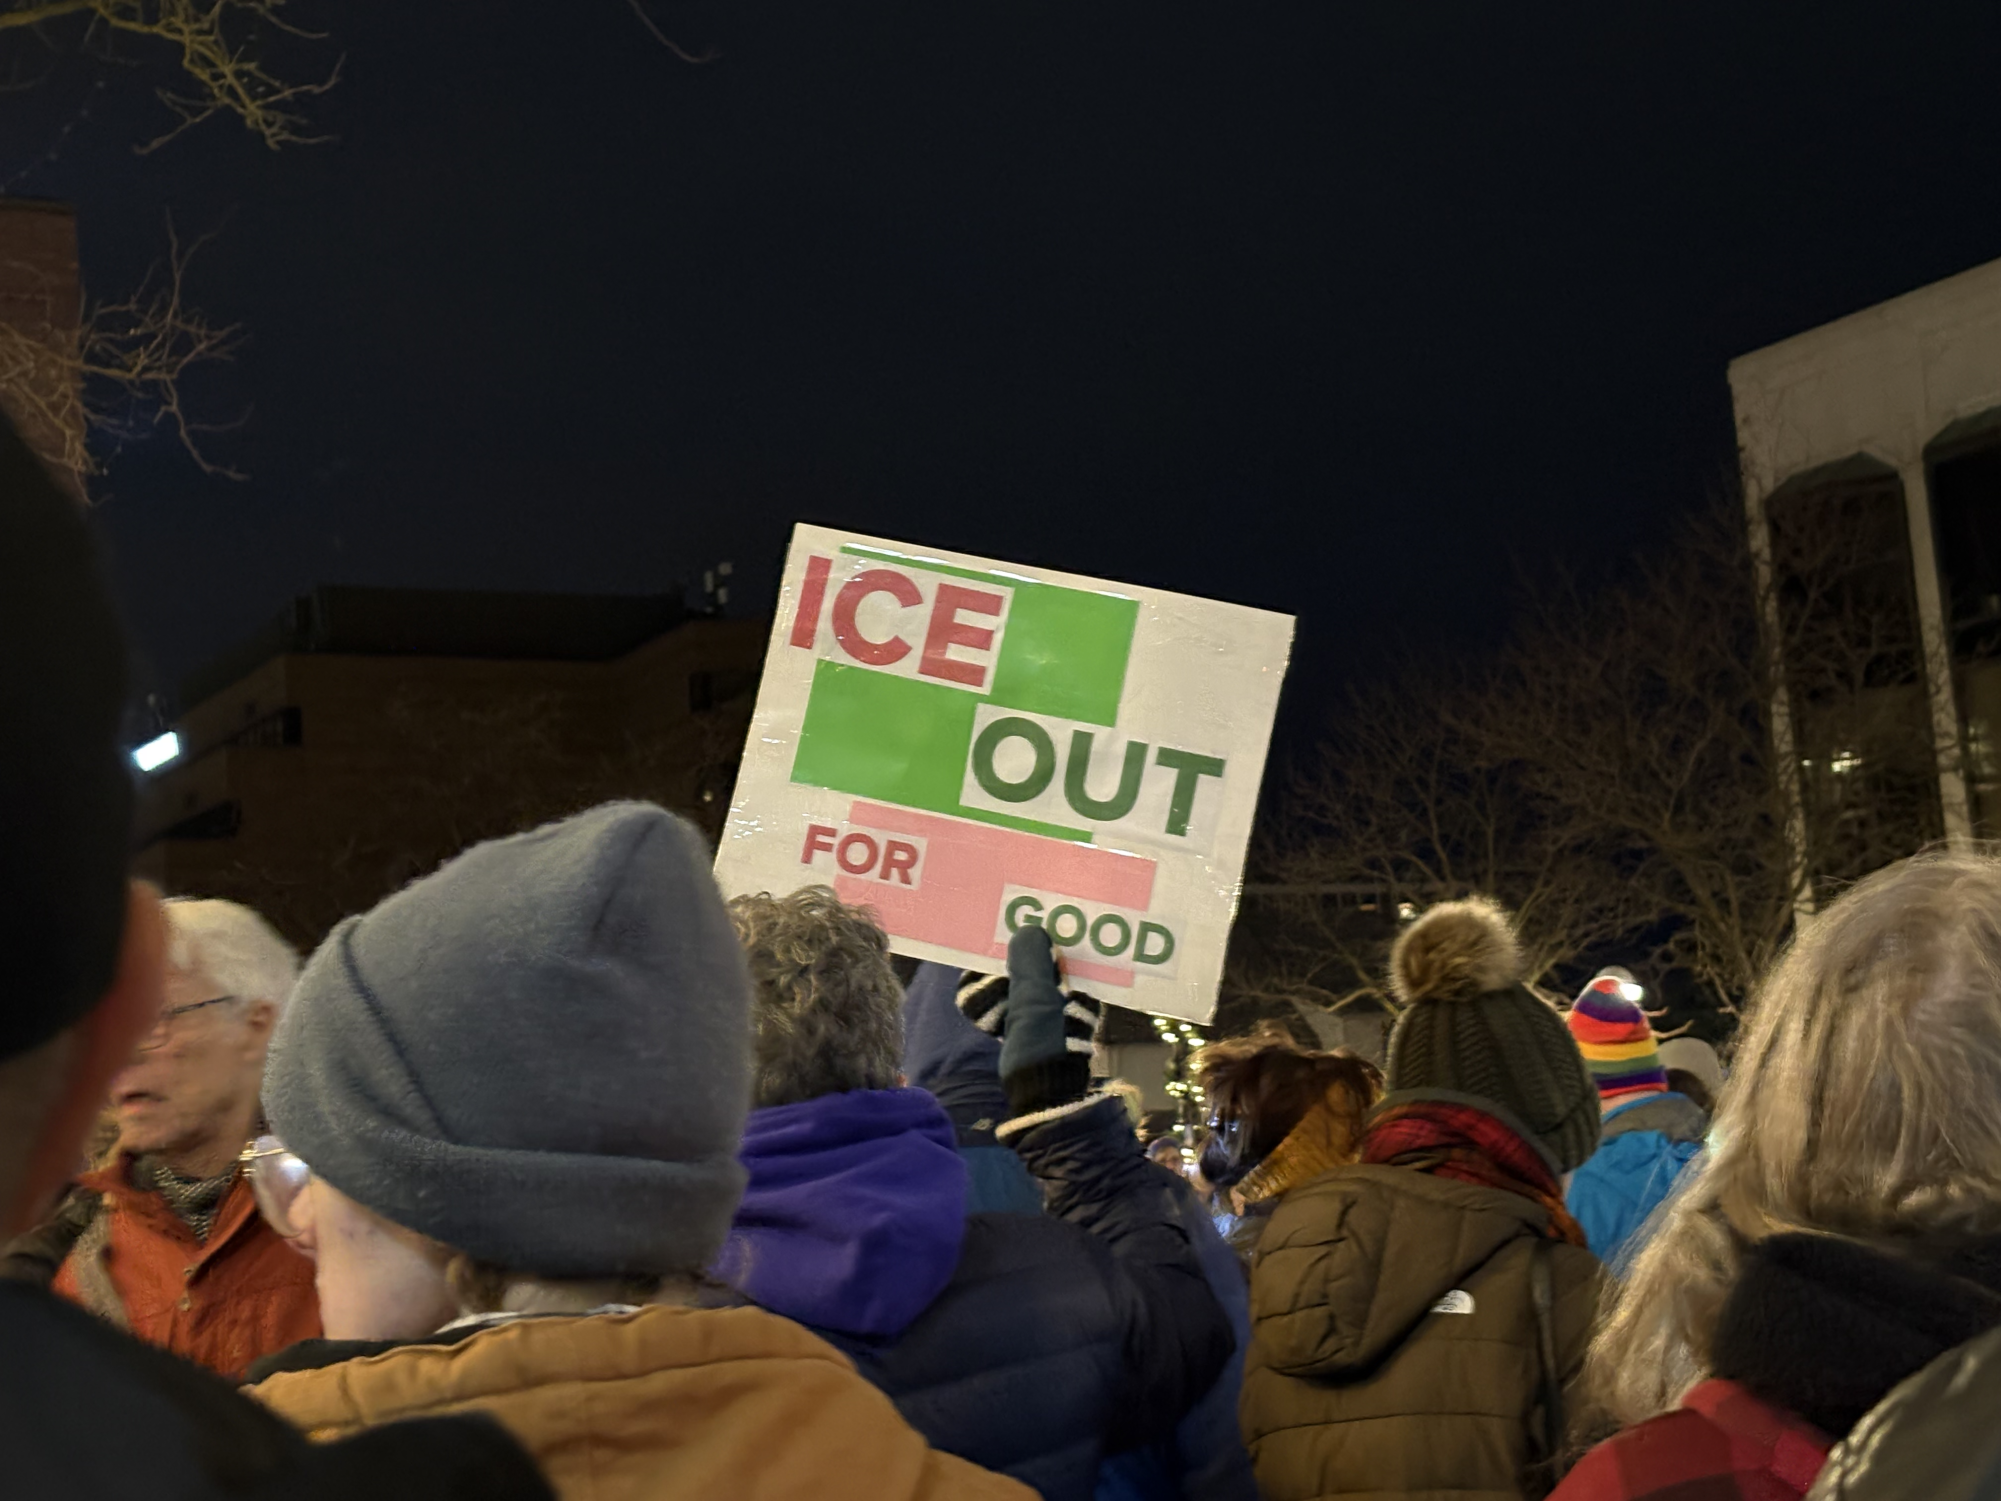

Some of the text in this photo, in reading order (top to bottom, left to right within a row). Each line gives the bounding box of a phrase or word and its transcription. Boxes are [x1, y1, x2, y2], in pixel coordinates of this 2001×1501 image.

[790, 555, 1005, 687] ICE
[971, 716, 1225, 836] OUT
[800, 824, 919, 885] FOR
[1005, 895, 1175, 965] GOOD
